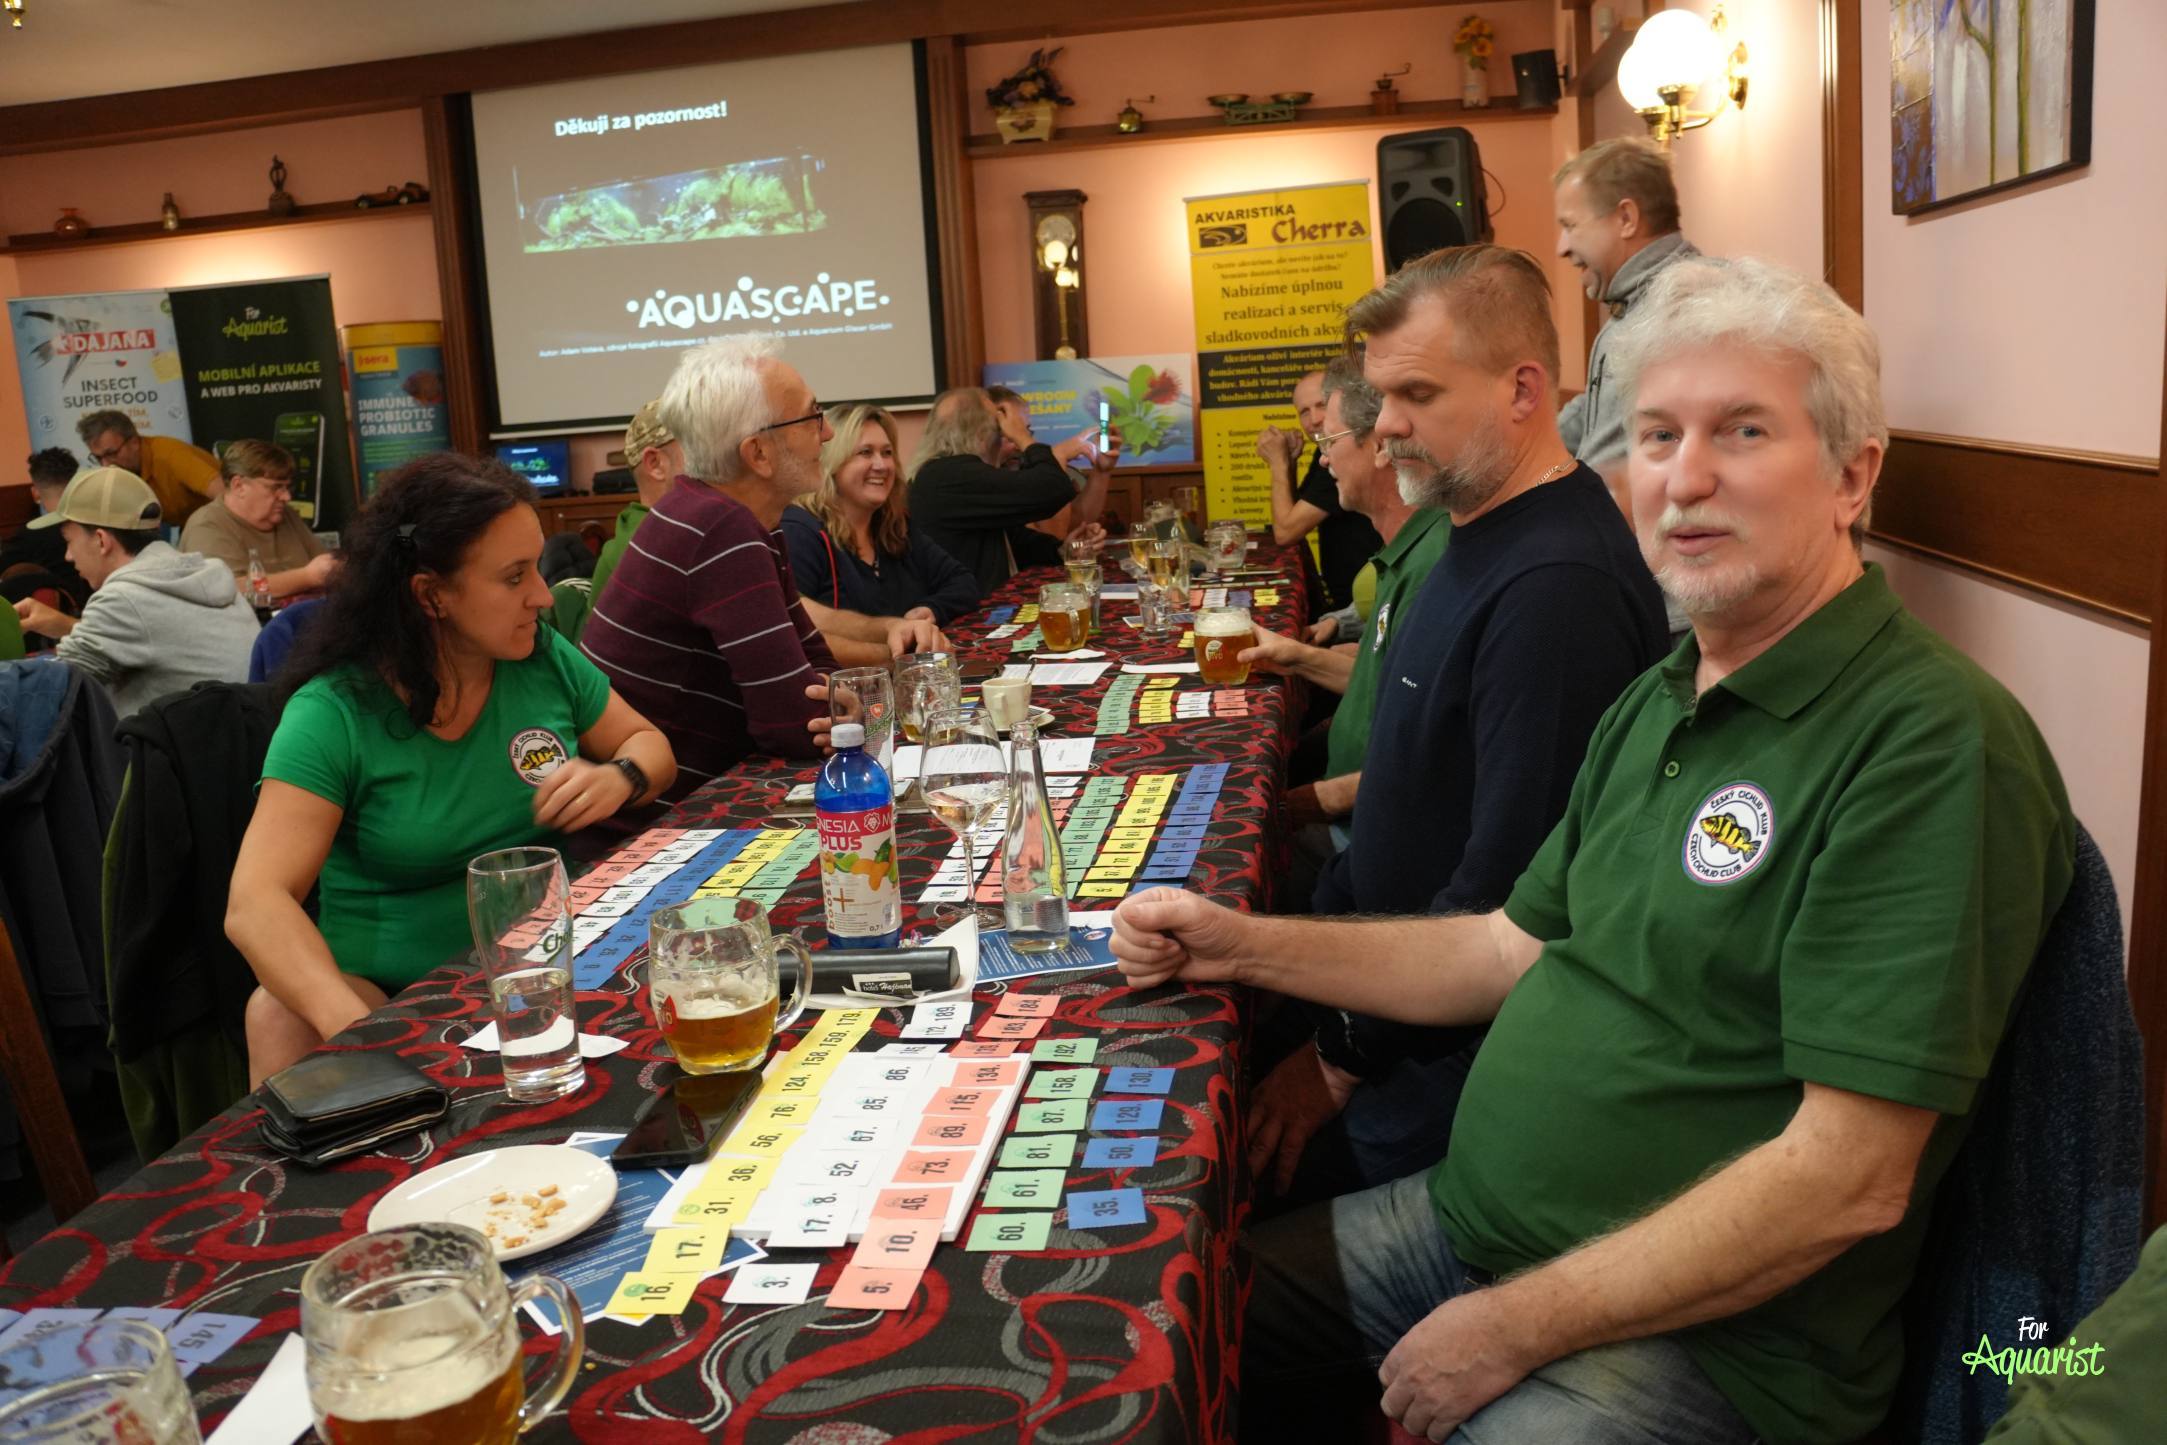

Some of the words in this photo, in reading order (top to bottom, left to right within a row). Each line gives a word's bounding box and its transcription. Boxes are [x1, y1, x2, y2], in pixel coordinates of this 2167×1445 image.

[554, 115, 609, 137] Děkuji
[612, 114, 631, 130] za
[635, 101, 728, 130] pozornost!
[1195, 204, 1296, 224] AKVARISTIKA
[1271, 217, 1366, 243] Cherra
[1292, 279, 1343, 296] úplnou
[1224, 304, 1285, 321] realizaci
[1288, 306, 1296, 316] a
[1300, 301, 1343, 315] servis
[74, 332, 149, 351] DAJANA
[1205, 325, 1310, 345] sladkovodních
[198, 363, 256, 383] MOBILNÍ
[259, 360, 321, 378] APLIKACE
[81, 377, 138, 392] INSECT
[200, 387, 209, 399] A
[211, 385, 235, 398] WEB
[238, 383, 260, 396] PRO
[262, 378, 322, 394] AKVARISTY
[64, 390, 159, 409] SUPERFOOD
[359, 407, 436, 424] PROBIOTIC
[360, 420, 433, 437] GRANULES
[1738, 790, 1764, 810] CICHLID
[821, 834, 863, 852] PLUS
[1692, 860, 1719, 878] CICHLID
[1719, 864, 1742, 878] CLUB
[935, 1003, 956, 1022] 189.
[1018, 997, 1042, 1013] 184.
[836, 1010, 863, 1027] 179.
[819, 1029, 850, 1047] 159.
[801, 1049, 831, 1067] 158.
[1053, 1042, 1077, 1059] 192.
[781, 1073, 812, 1092] 124.
[885, 1066, 911, 1081] 86.
[976, 1064, 1001, 1083] 134.
[1050, 1074, 1077, 1094] 158.
[862, 1096, 889, 1111] 85.
[949, 1091, 982, 1111] 115.
[770, 1103, 798, 1119] 76.
[1041, 1108, 1065, 1125] 87.
[850, 1126, 878, 1143] 67.
[940, 1123, 968, 1139] 89.
[750, 1132, 783, 1149] 56.
[1026, 1143, 1053, 1159] 81.
[728, 1164, 758, 1182] 36.
[829, 1159, 860, 1178] 52.
[921, 1158, 951, 1175] 73.
[1012, 1179, 1040, 1198] 61.
[704, 1197, 735, 1215] 31.
[812, 1192, 838, 1204] 8.
[900, 1193, 929, 1211] 46.
[1094, 1197, 1118, 1217] 35.
[802, 1213, 833, 1234] 17.
[997, 1221, 1026, 1242] 60.
[675, 1235, 706, 1259] 17.
[885, 1229, 918, 1254] 10.
[641, 1281, 674, 1302] 16.
[762, 1276, 791, 1289] 3.
[863, 1281, 893, 1295] 5.
